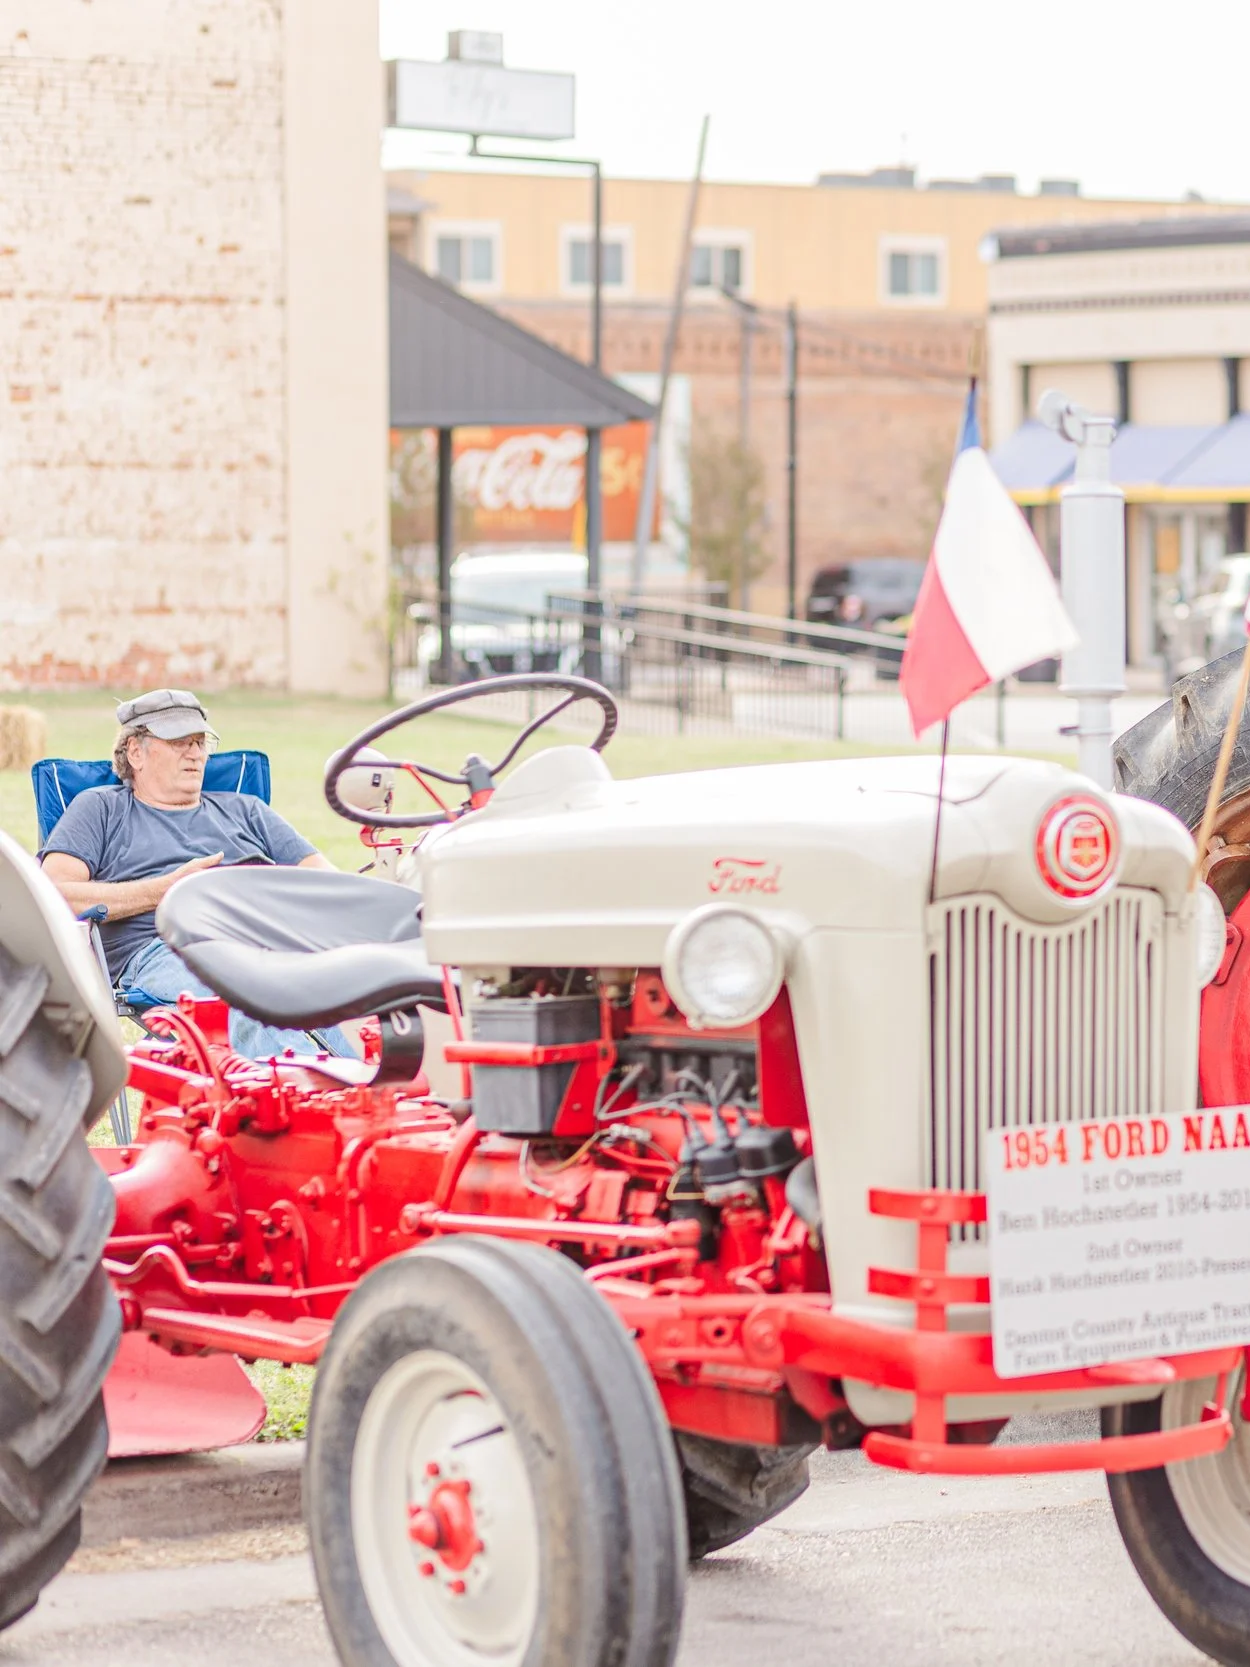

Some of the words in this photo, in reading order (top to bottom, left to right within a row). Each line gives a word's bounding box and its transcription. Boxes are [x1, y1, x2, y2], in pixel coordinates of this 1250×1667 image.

[708, 857, 782, 894] Ford
[1004, 1128, 1067, 1169] 1954
[1082, 1120, 1169, 1161] FORD
[1183, 1113, 1250, 1151] NAA
[1083, 1174, 1109, 1194] 1st
[1115, 1169, 1182, 1190] Owner
[998, 1211, 1036, 1233] Ben
[1087, 1242, 1120, 1262] 2nd
[1124, 1239, 1183, 1257] Owner
[1072, 1318, 1135, 1339] County
[1141, 1311, 1207, 1334] Antique
[1014, 1351, 1058, 1368] Farm
[1063, 1338, 1156, 1364] Equipment
